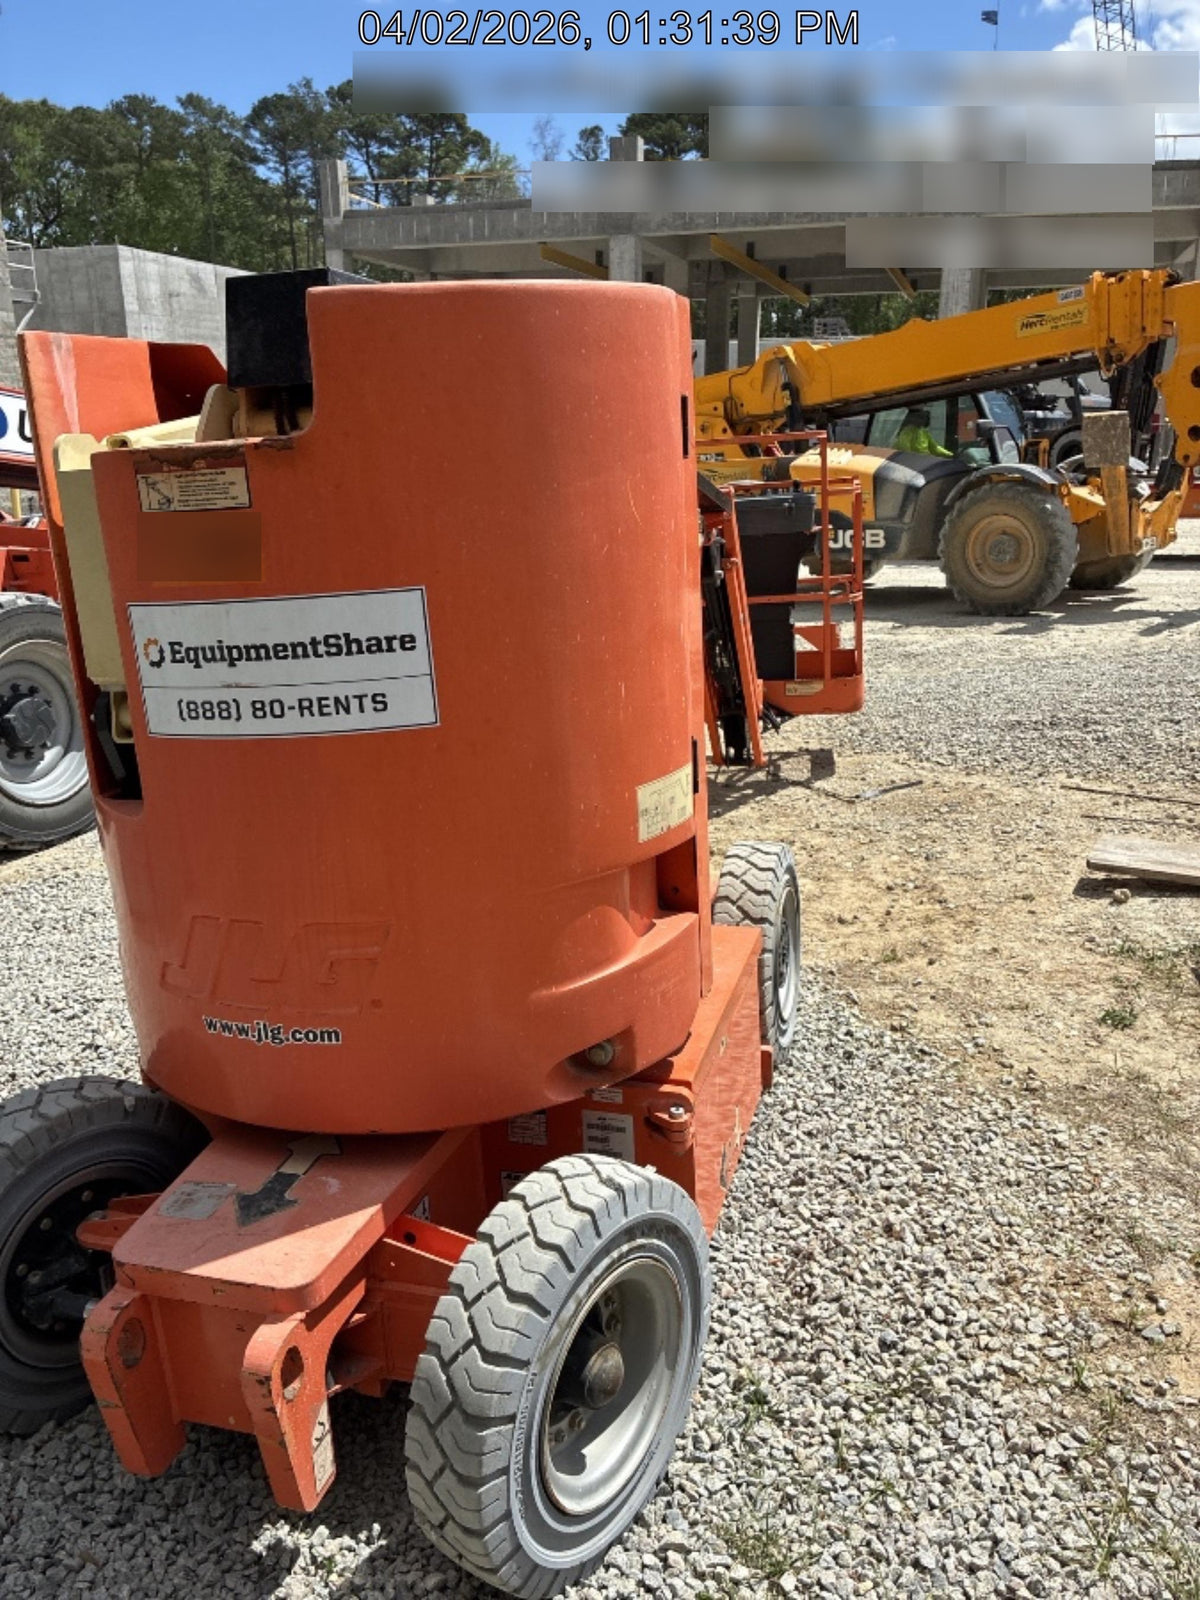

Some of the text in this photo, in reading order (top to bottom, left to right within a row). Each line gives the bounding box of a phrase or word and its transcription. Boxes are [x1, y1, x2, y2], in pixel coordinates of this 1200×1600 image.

[828, 529, 886, 549] JCB
[168, 632, 417, 669] EquipmentShare
[177, 692, 389, 722] (888) 80-RENTS
[160, 914, 391, 1015] JLG
[202, 1015, 342, 1046] www.jlg.com
